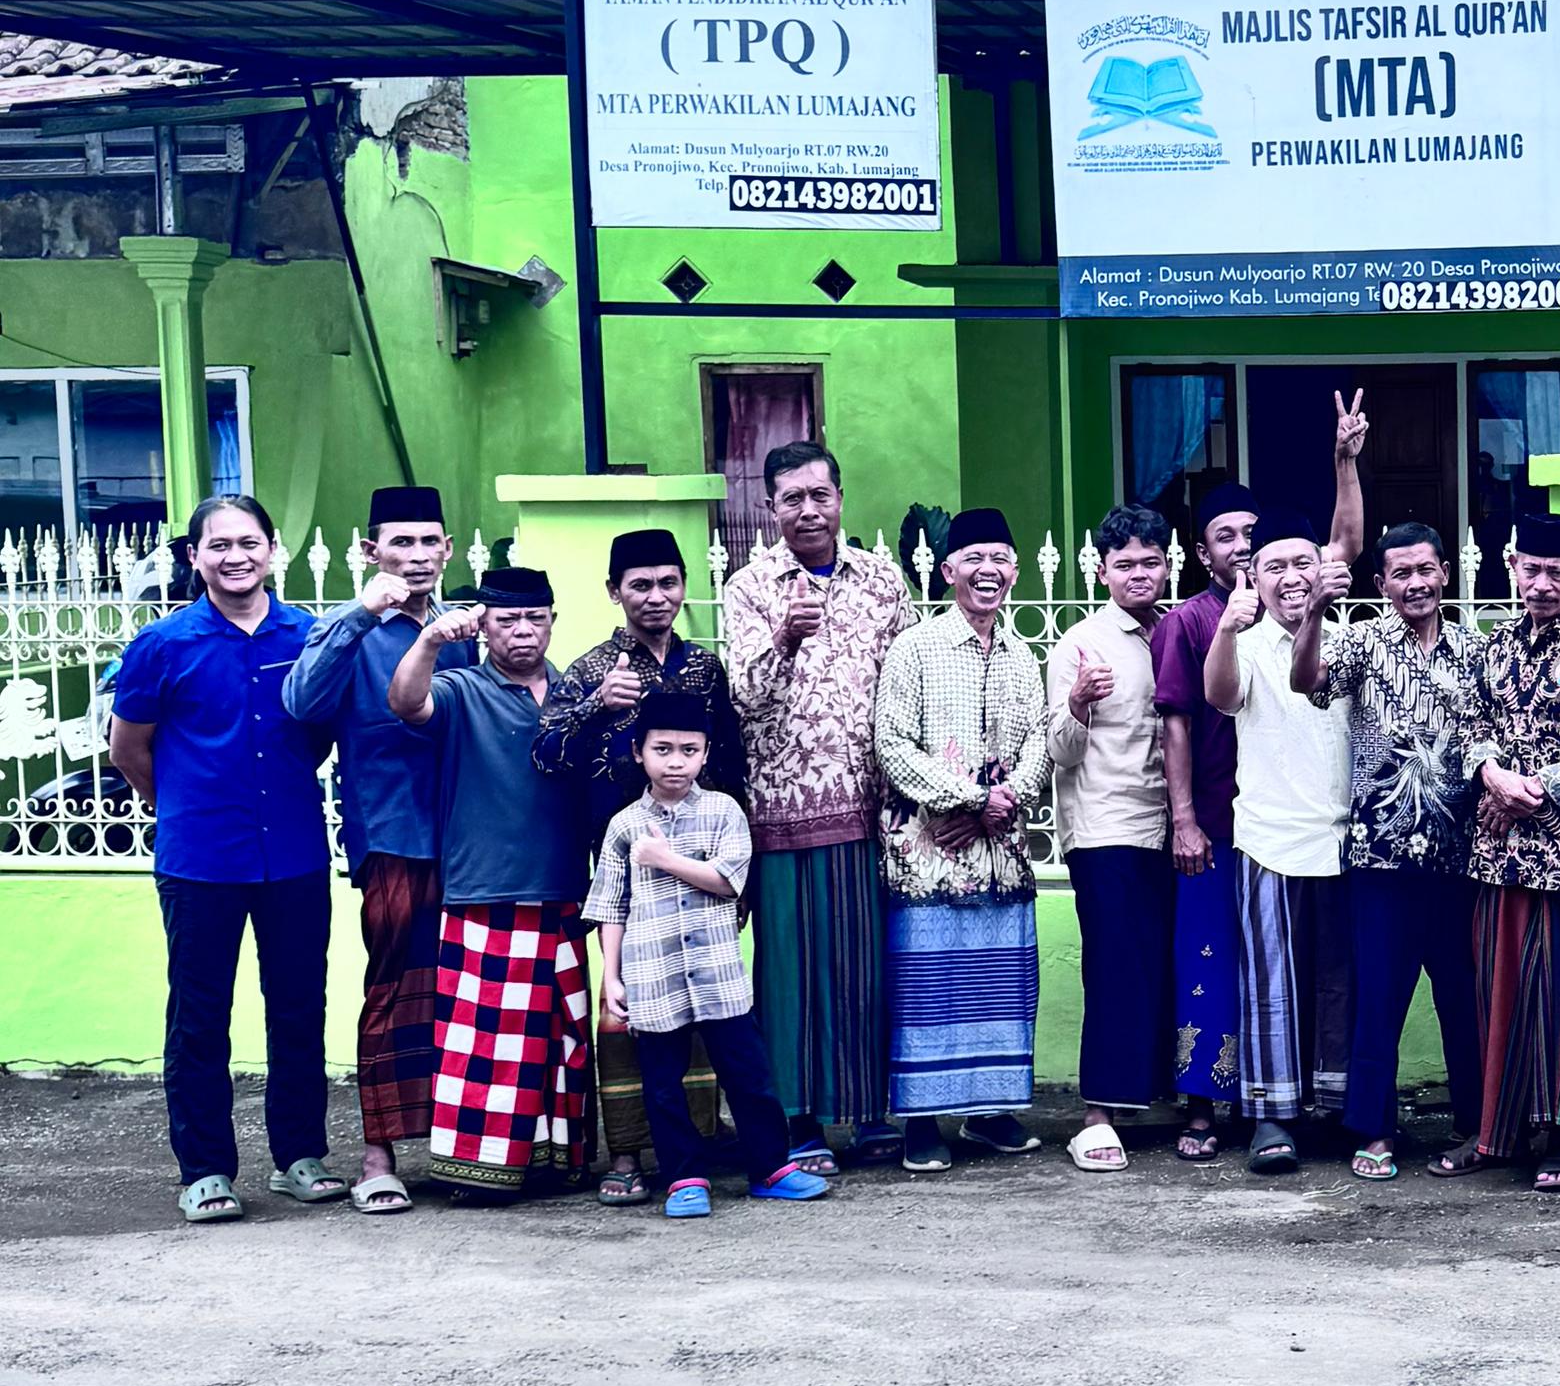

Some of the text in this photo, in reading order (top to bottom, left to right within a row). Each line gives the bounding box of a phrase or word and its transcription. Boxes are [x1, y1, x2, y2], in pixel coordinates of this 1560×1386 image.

[1221, 9, 1313, 43] MAJLIS
[1319, 6, 1407, 41] TAFSIR
[1414, 4, 1447, 38] AL
[1314, 51, 1457, 122] (MTA)
[597, 93, 917, 117] MTA PERWAKILAN LUMAJANG
[627, 142, 889, 159] Alamat: Dusun Mulyoarjo RT.07 RW.20
[1251, 138, 1397, 167] PERWAKILAN
[1404, 133, 1524, 163] LUMAJANG
[599, 160, 630, 173] Desa
[709, 161, 738, 173] Kec.
[817, 162, 849, 175] Kab.
[853, 163, 920, 178] Lumajang
[695, 178, 935, 212] Telp. 082143982001
[1080, 267, 1141, 284] Alamat
[1159, 266, 1214, 283] Dusun
[1219, 264, 1306, 284] Mulyoarjo
[1312, 263, 1357, 279] RT.07
[1364, 262, 1395, 279] RW.
[1402, 261, 1425, 278] 20
[1431, 260, 1475, 276] Desa
[1097, 291, 1133, 307] Kec.
[1139, 290, 1224, 309] Pronojiwo
[1230, 288, 1268, 305] Kab.
[1275, 287, 1360, 307] Lumajang
